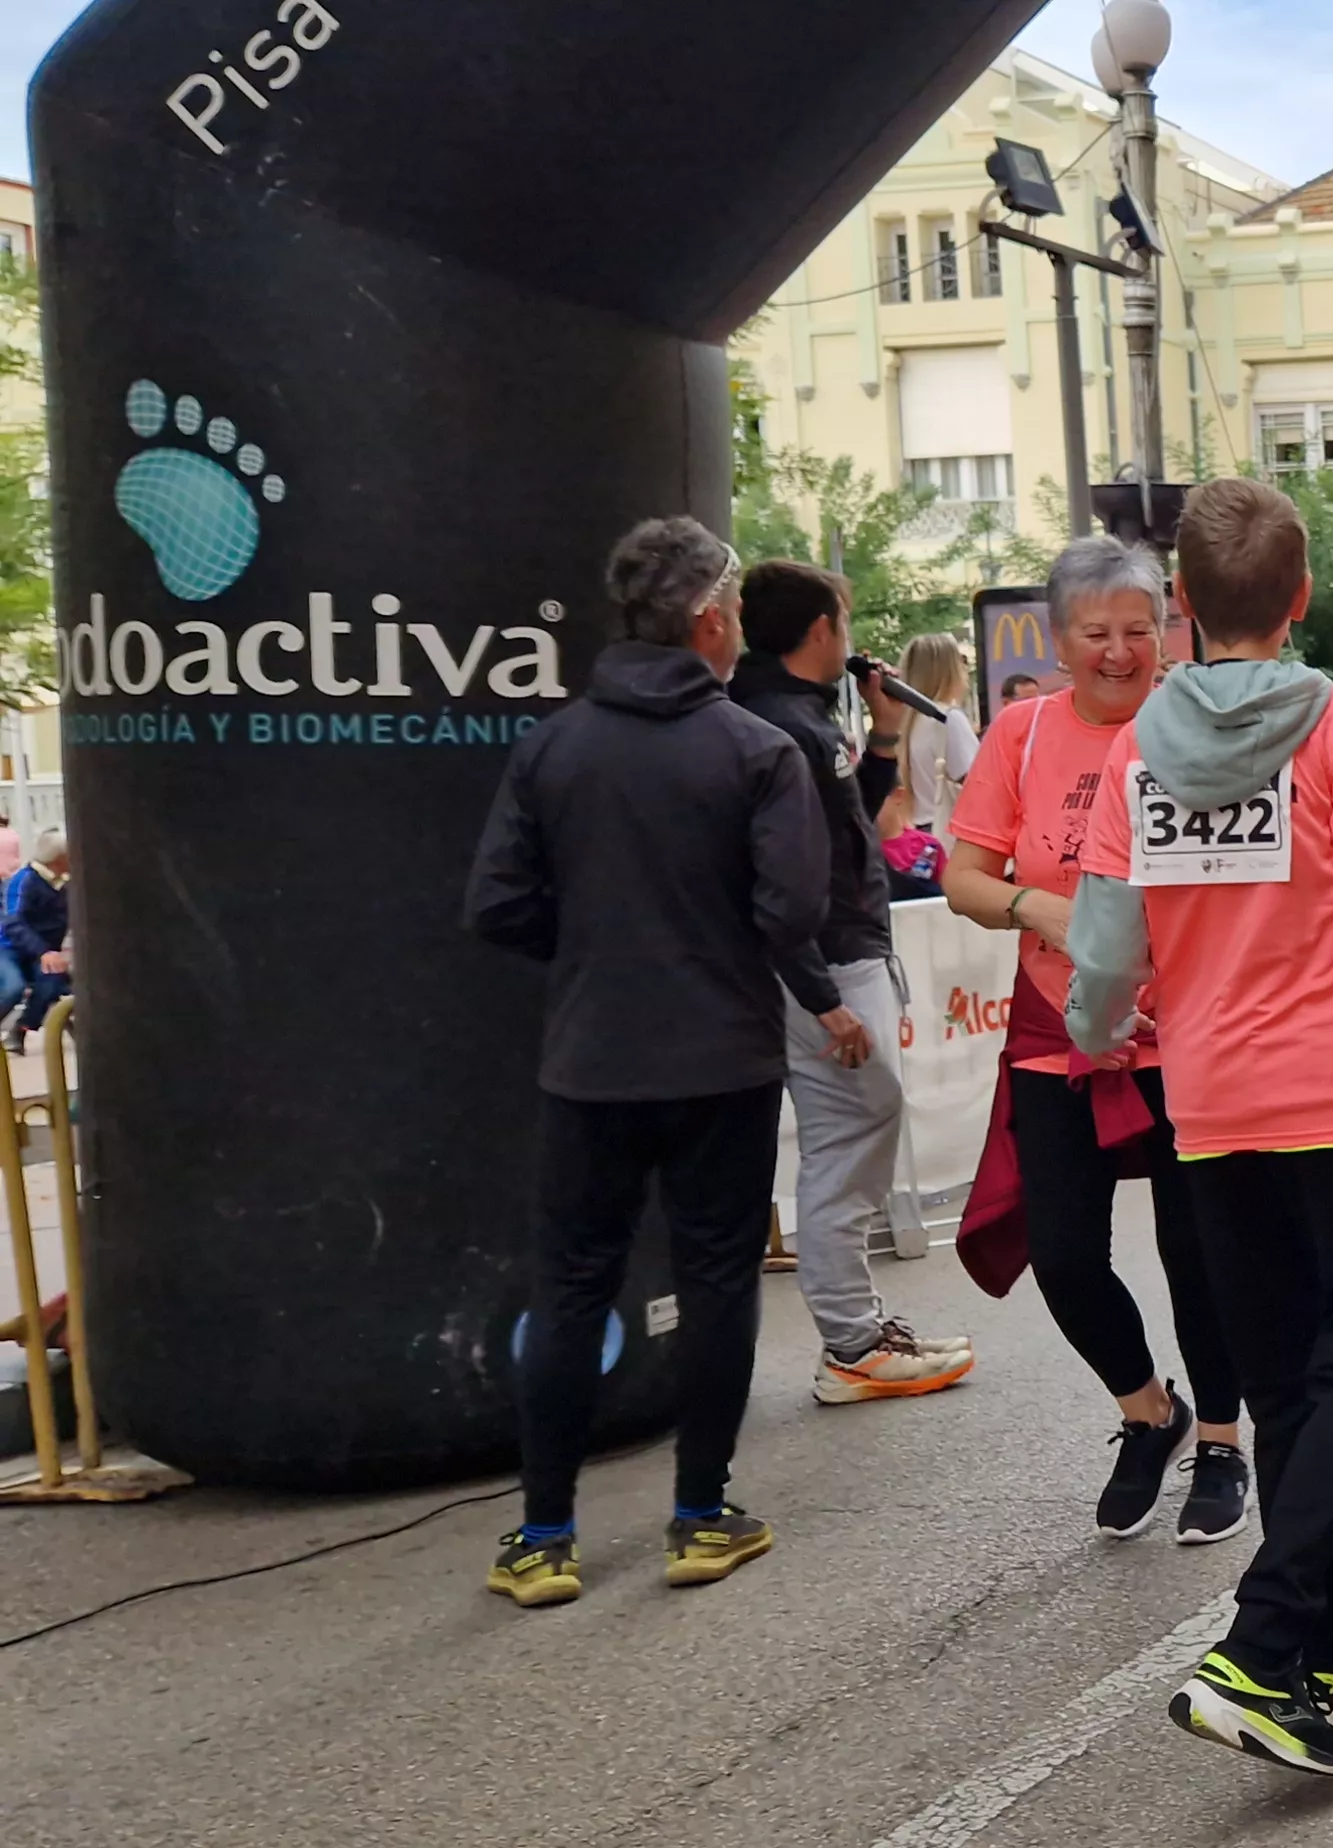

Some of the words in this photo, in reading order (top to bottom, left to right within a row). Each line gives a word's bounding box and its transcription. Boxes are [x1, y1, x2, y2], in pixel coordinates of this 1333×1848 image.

[166, 0, 341, 156] Pisa
[210, 713, 230, 743] Y
[250, 706, 541, 744] BIOMECÁNIC
[1146, 797, 1276, 848] 3422
